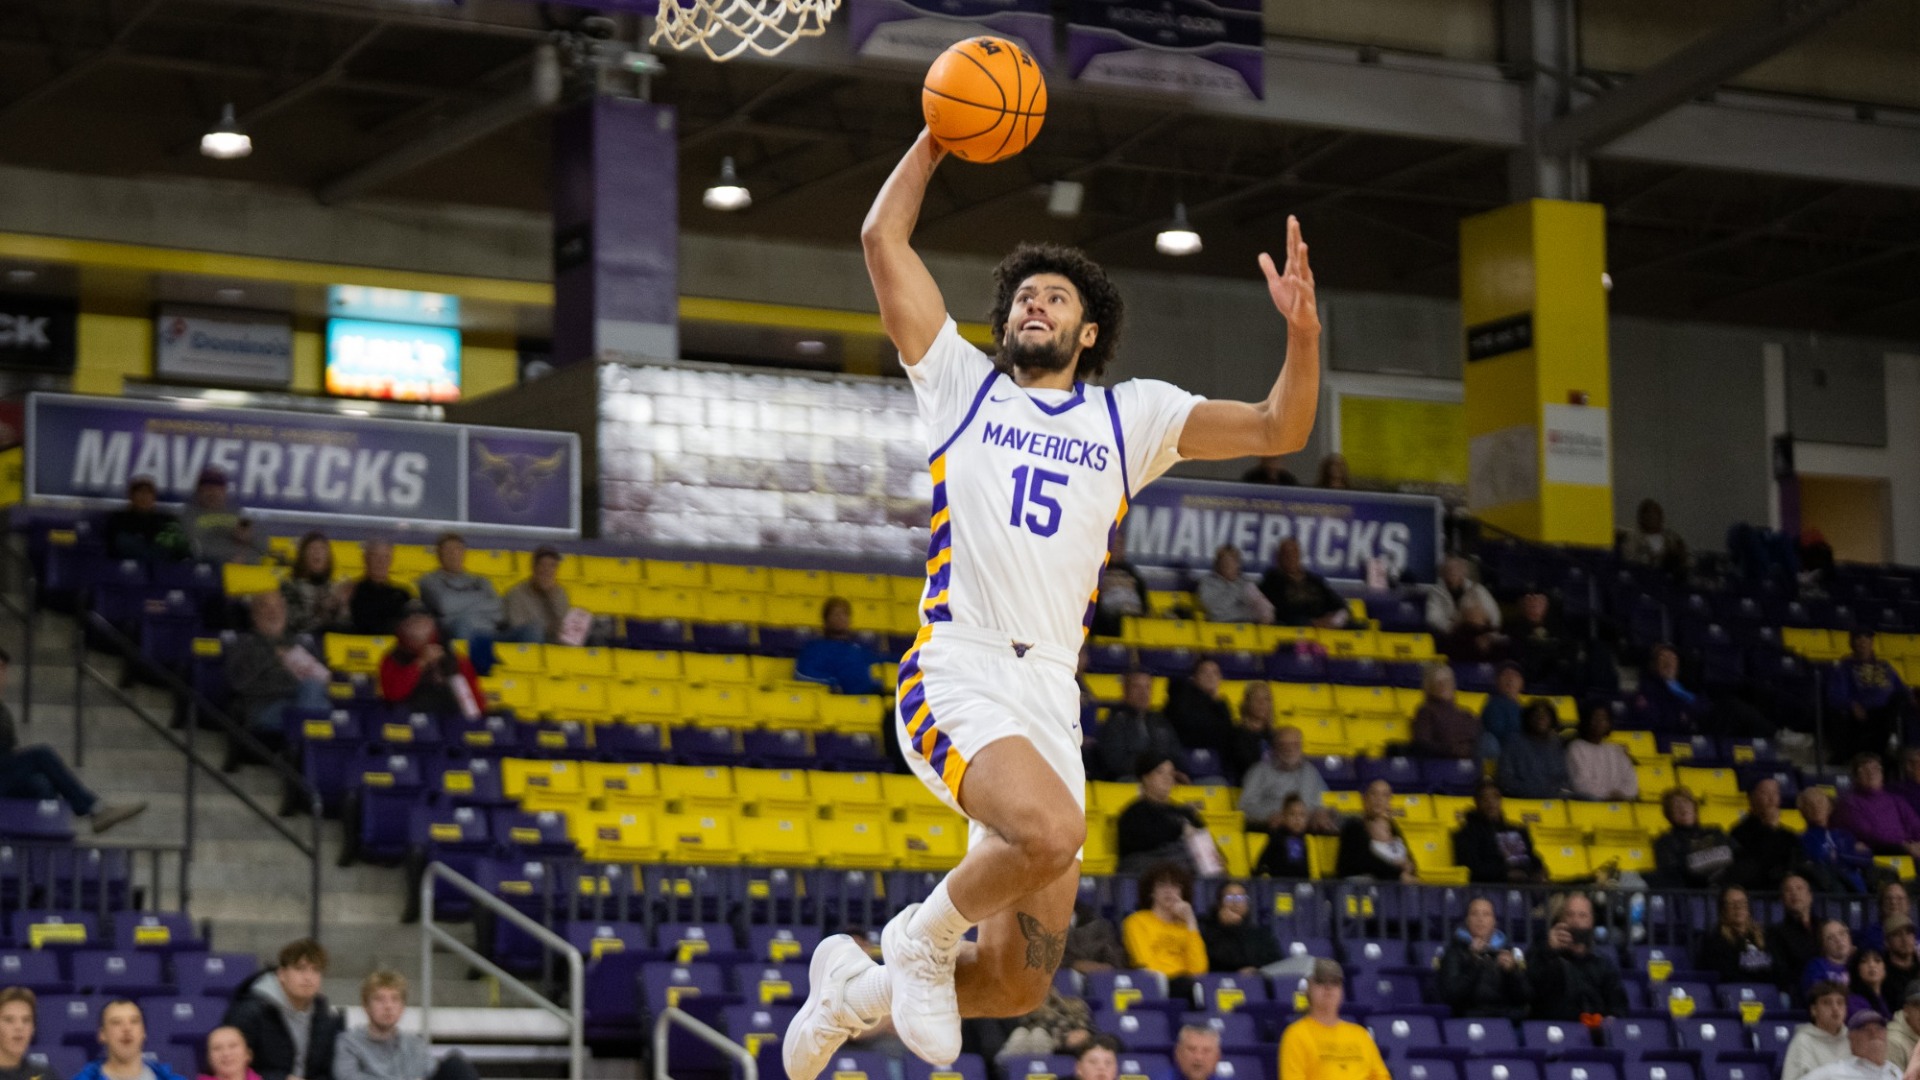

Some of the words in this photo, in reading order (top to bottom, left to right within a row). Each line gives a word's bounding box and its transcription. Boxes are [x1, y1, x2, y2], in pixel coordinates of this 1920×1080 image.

[72, 428, 428, 508] MAVERICKS
[982, 421, 1109, 472] MAVERICKS
[1010, 464, 1069, 538] 15
[1125, 504, 1411, 578] MAVERICKS
